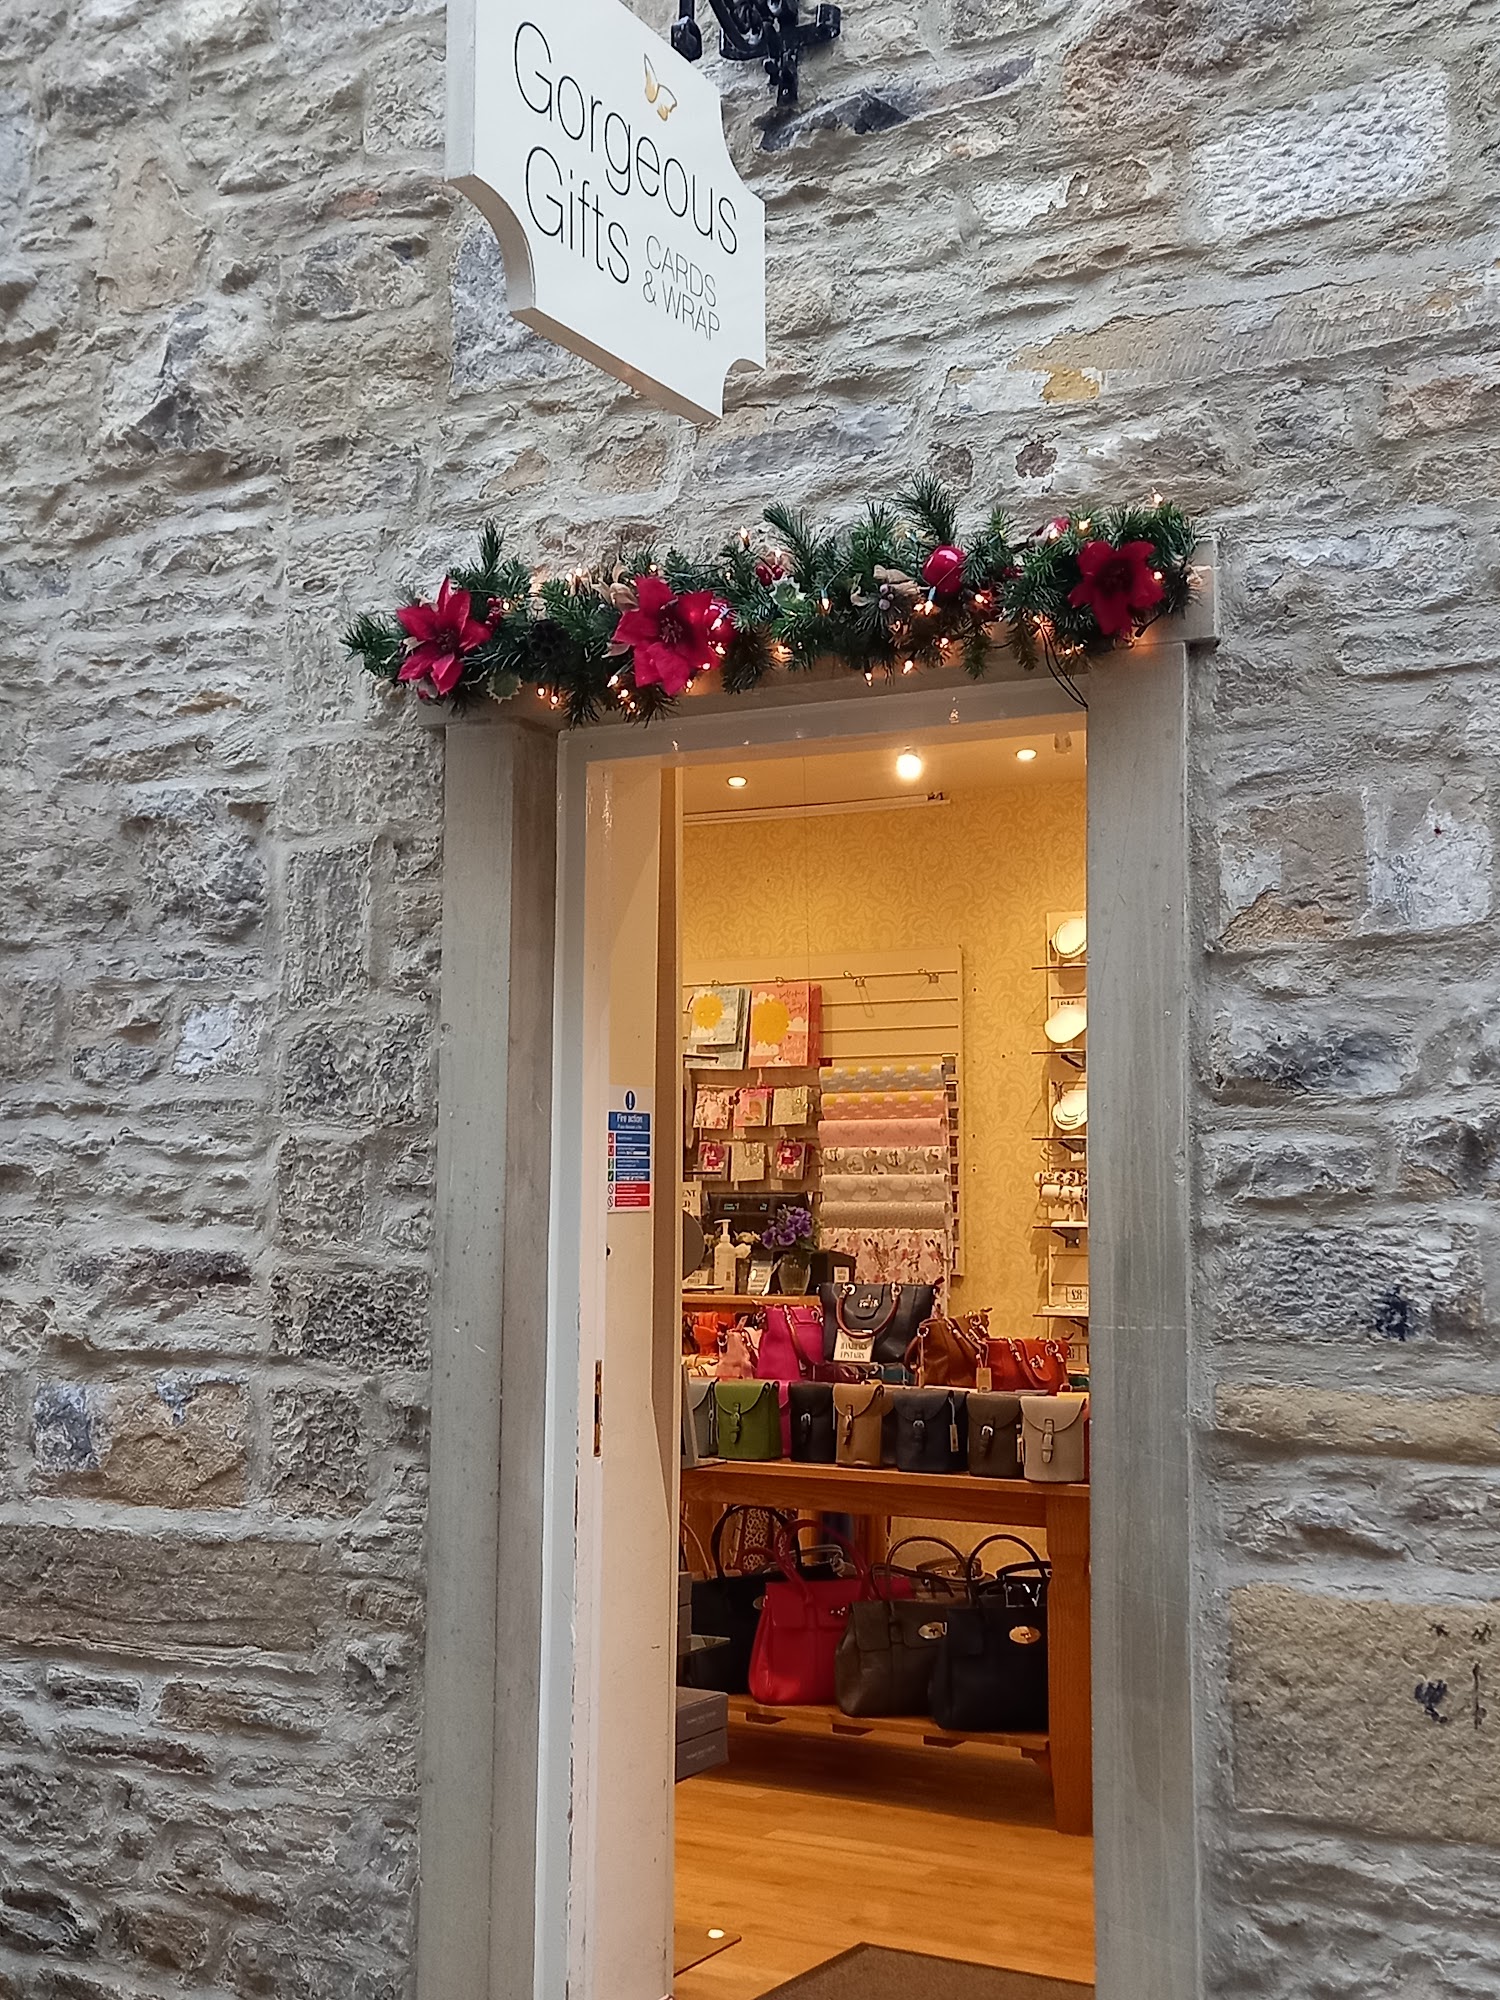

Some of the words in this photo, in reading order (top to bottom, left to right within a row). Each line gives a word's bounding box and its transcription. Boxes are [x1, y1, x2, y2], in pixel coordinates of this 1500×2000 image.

[514, 22, 737, 255] Gorgeous
[525, 146, 629, 284] Gifts
[642, 270, 657, 306] &
[661, 288, 720, 340] WRAP
[646, 235, 716, 307] CARDS
